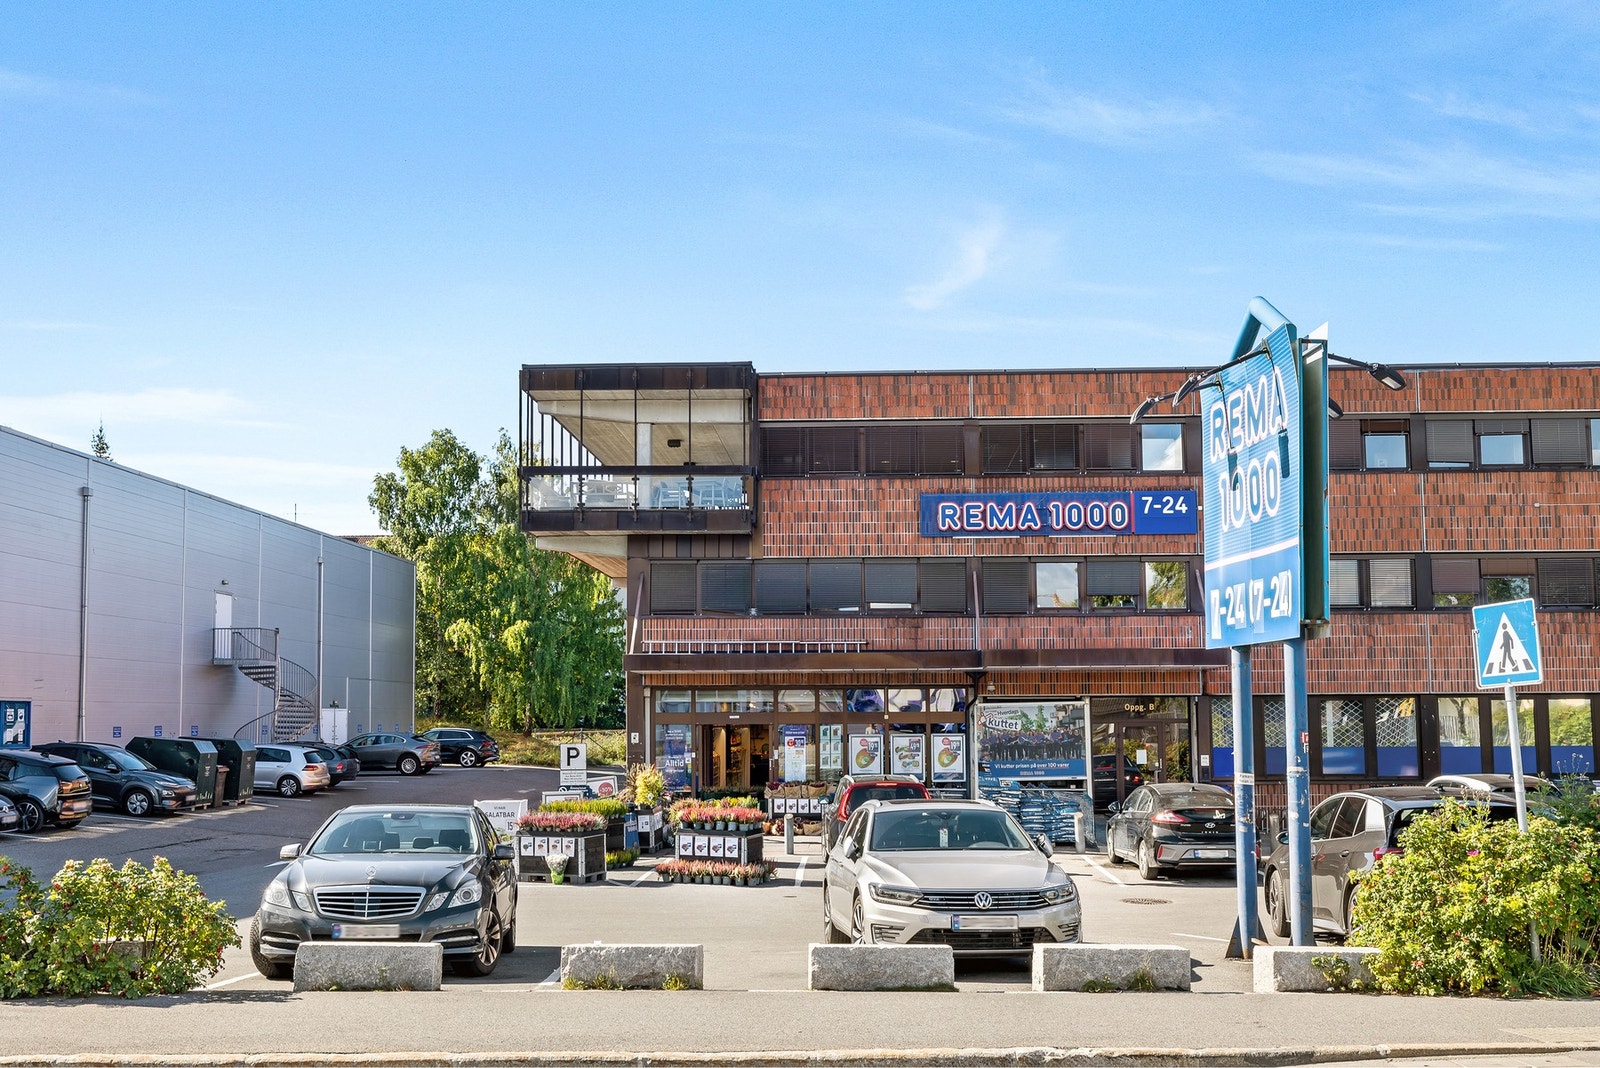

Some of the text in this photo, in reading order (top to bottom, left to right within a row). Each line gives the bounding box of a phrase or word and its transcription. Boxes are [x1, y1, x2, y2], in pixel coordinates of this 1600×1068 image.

[1210, 365, 1288, 463] REMA
[1218, 450, 1281, 532] 1000
[1141, 496, 1188, 514] 7-24
[938, 502, 1128, 531] REMA 1000
[1210, 584, 1246, 633] 7-24
[1124, 703, 1155, 712] Oppg. B
[987, 717, 1019, 730] kuttet
[566, 747, 580, 767] P
[665, 759, 685, 767] Alltid
